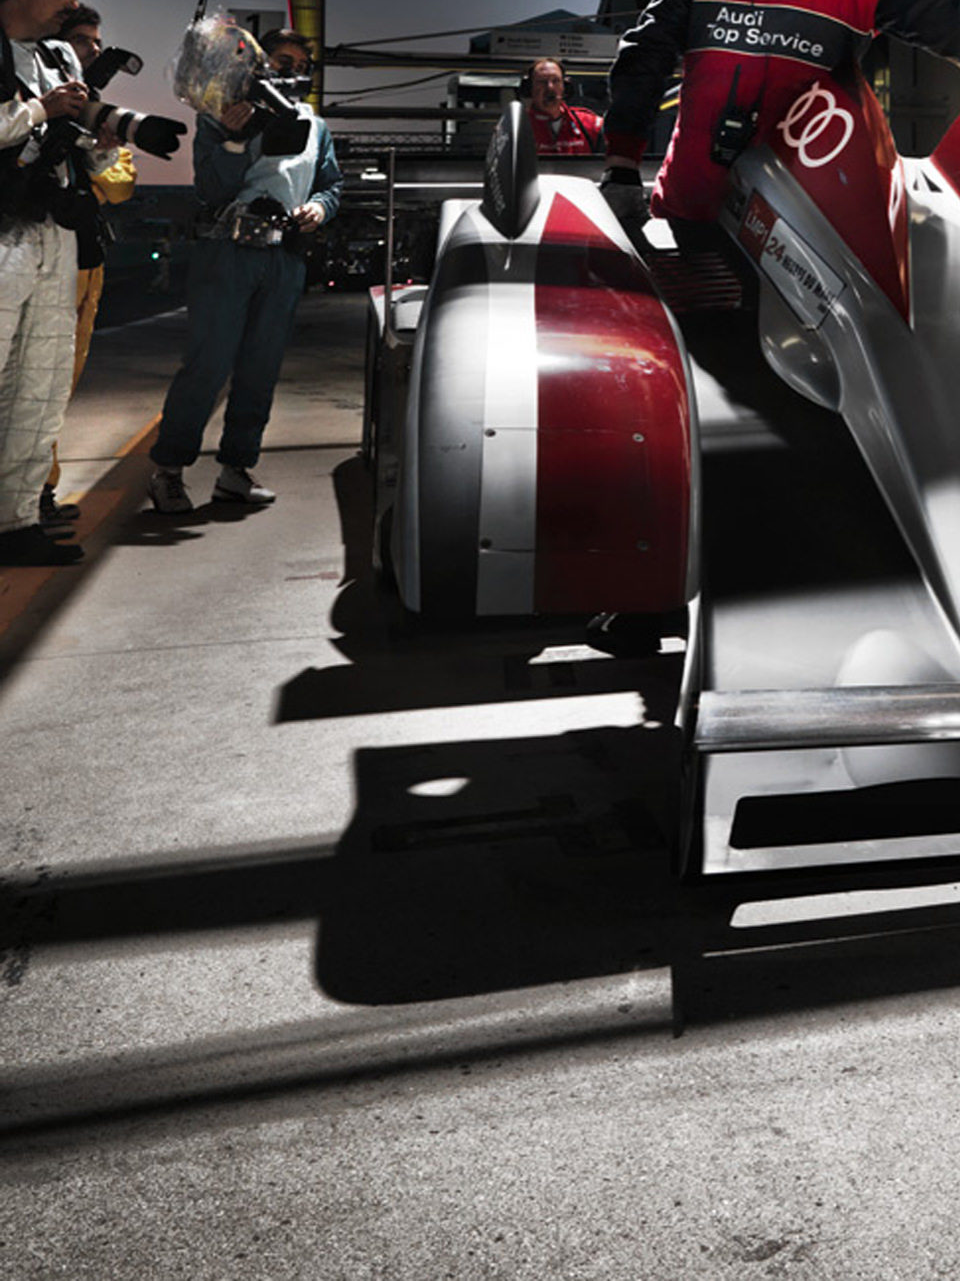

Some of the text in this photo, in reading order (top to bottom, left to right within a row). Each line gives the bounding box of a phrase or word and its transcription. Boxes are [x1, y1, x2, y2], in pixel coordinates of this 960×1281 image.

[715, 5, 765, 28] Audi
[706, 21, 824, 59] Top Service
